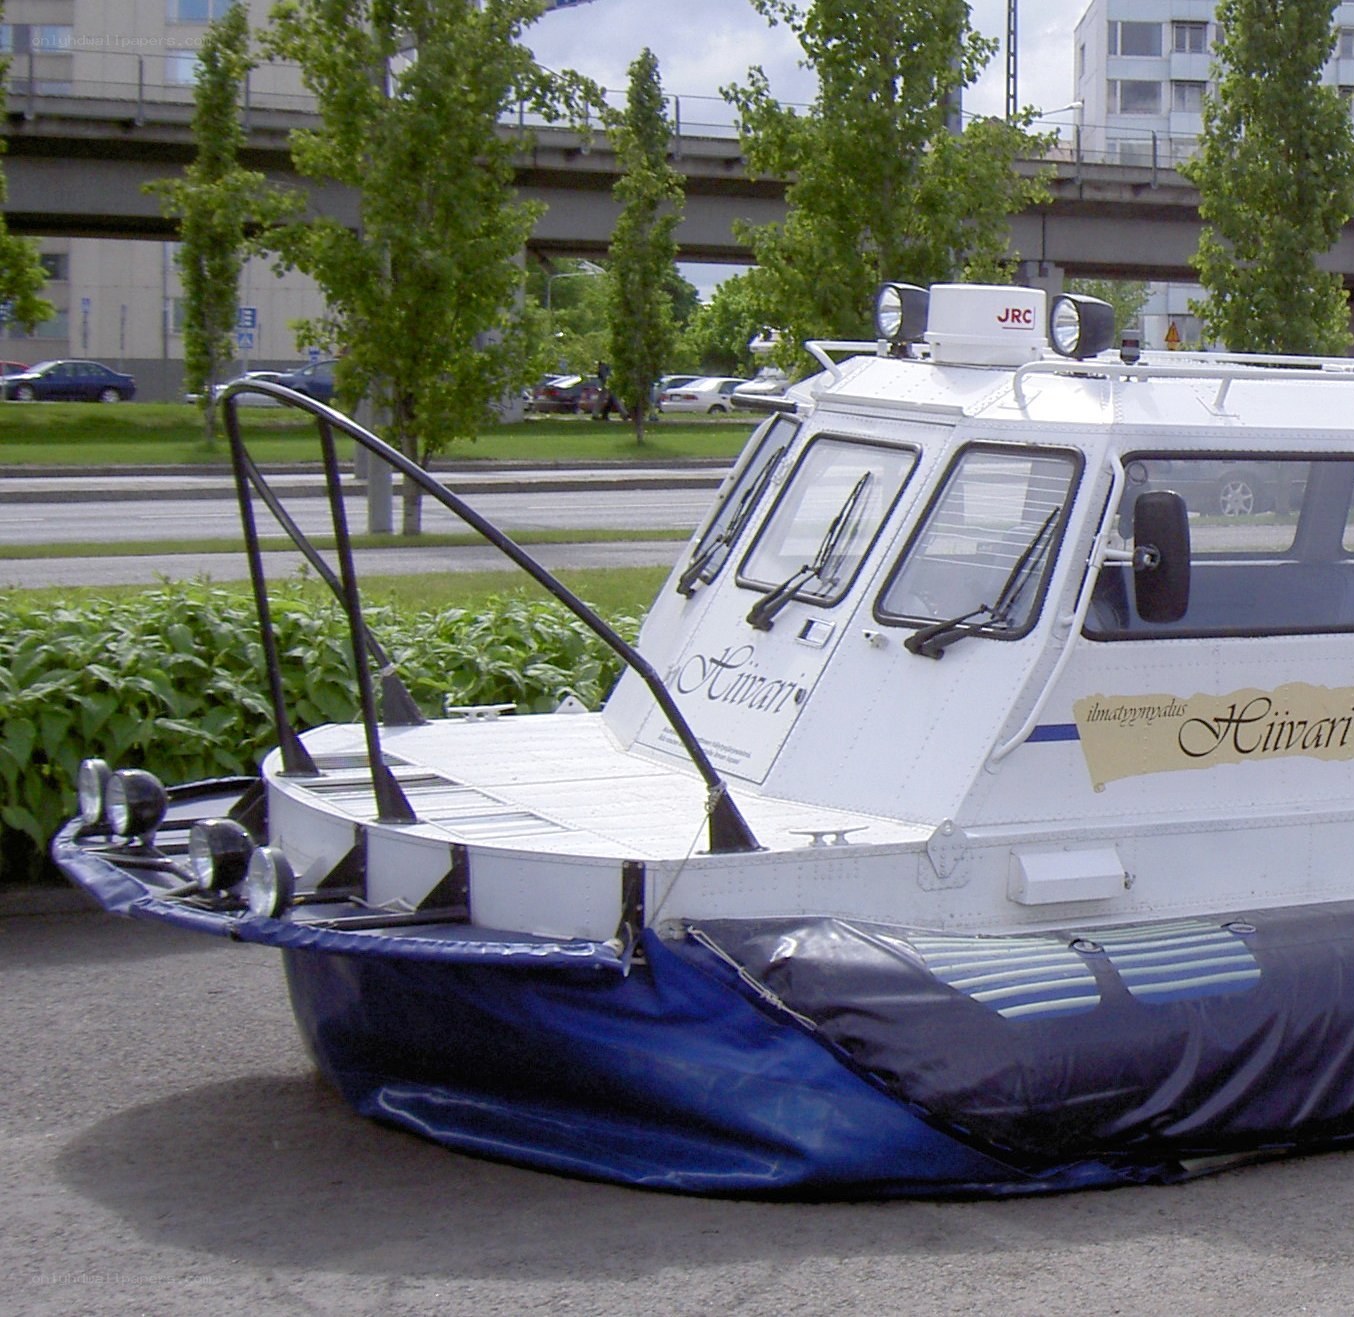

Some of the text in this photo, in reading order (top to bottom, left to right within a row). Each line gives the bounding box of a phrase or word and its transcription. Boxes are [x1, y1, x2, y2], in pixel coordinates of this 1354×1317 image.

[997, 308, 1033, 324] JRC
[677, 644, 806, 714] Hiivari
[1086, 697, 1188, 728] ilmatyynyalus
